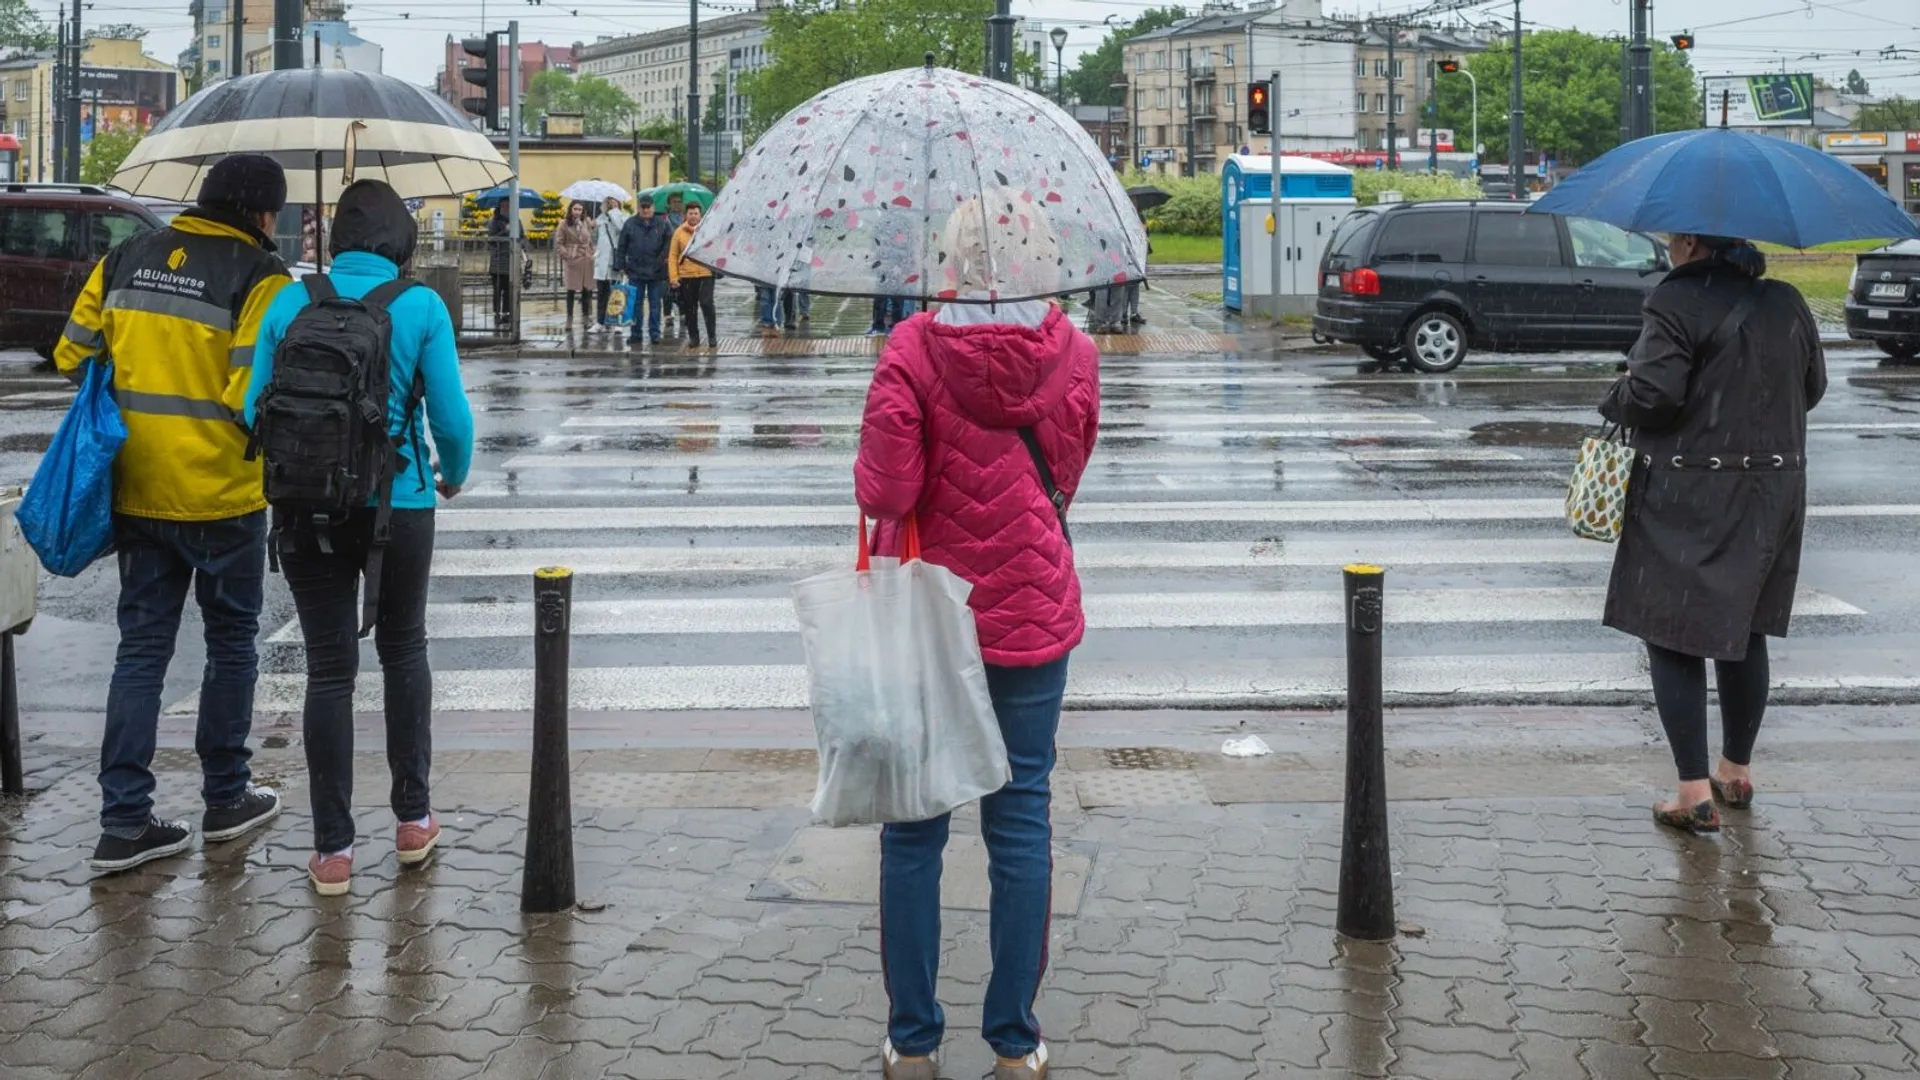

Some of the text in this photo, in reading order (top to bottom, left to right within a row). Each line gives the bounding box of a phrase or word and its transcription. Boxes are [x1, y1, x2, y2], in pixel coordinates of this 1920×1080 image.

[133, 268, 205, 288] ABUniverse
[133, 280, 203, 297] Universal Building Academy
